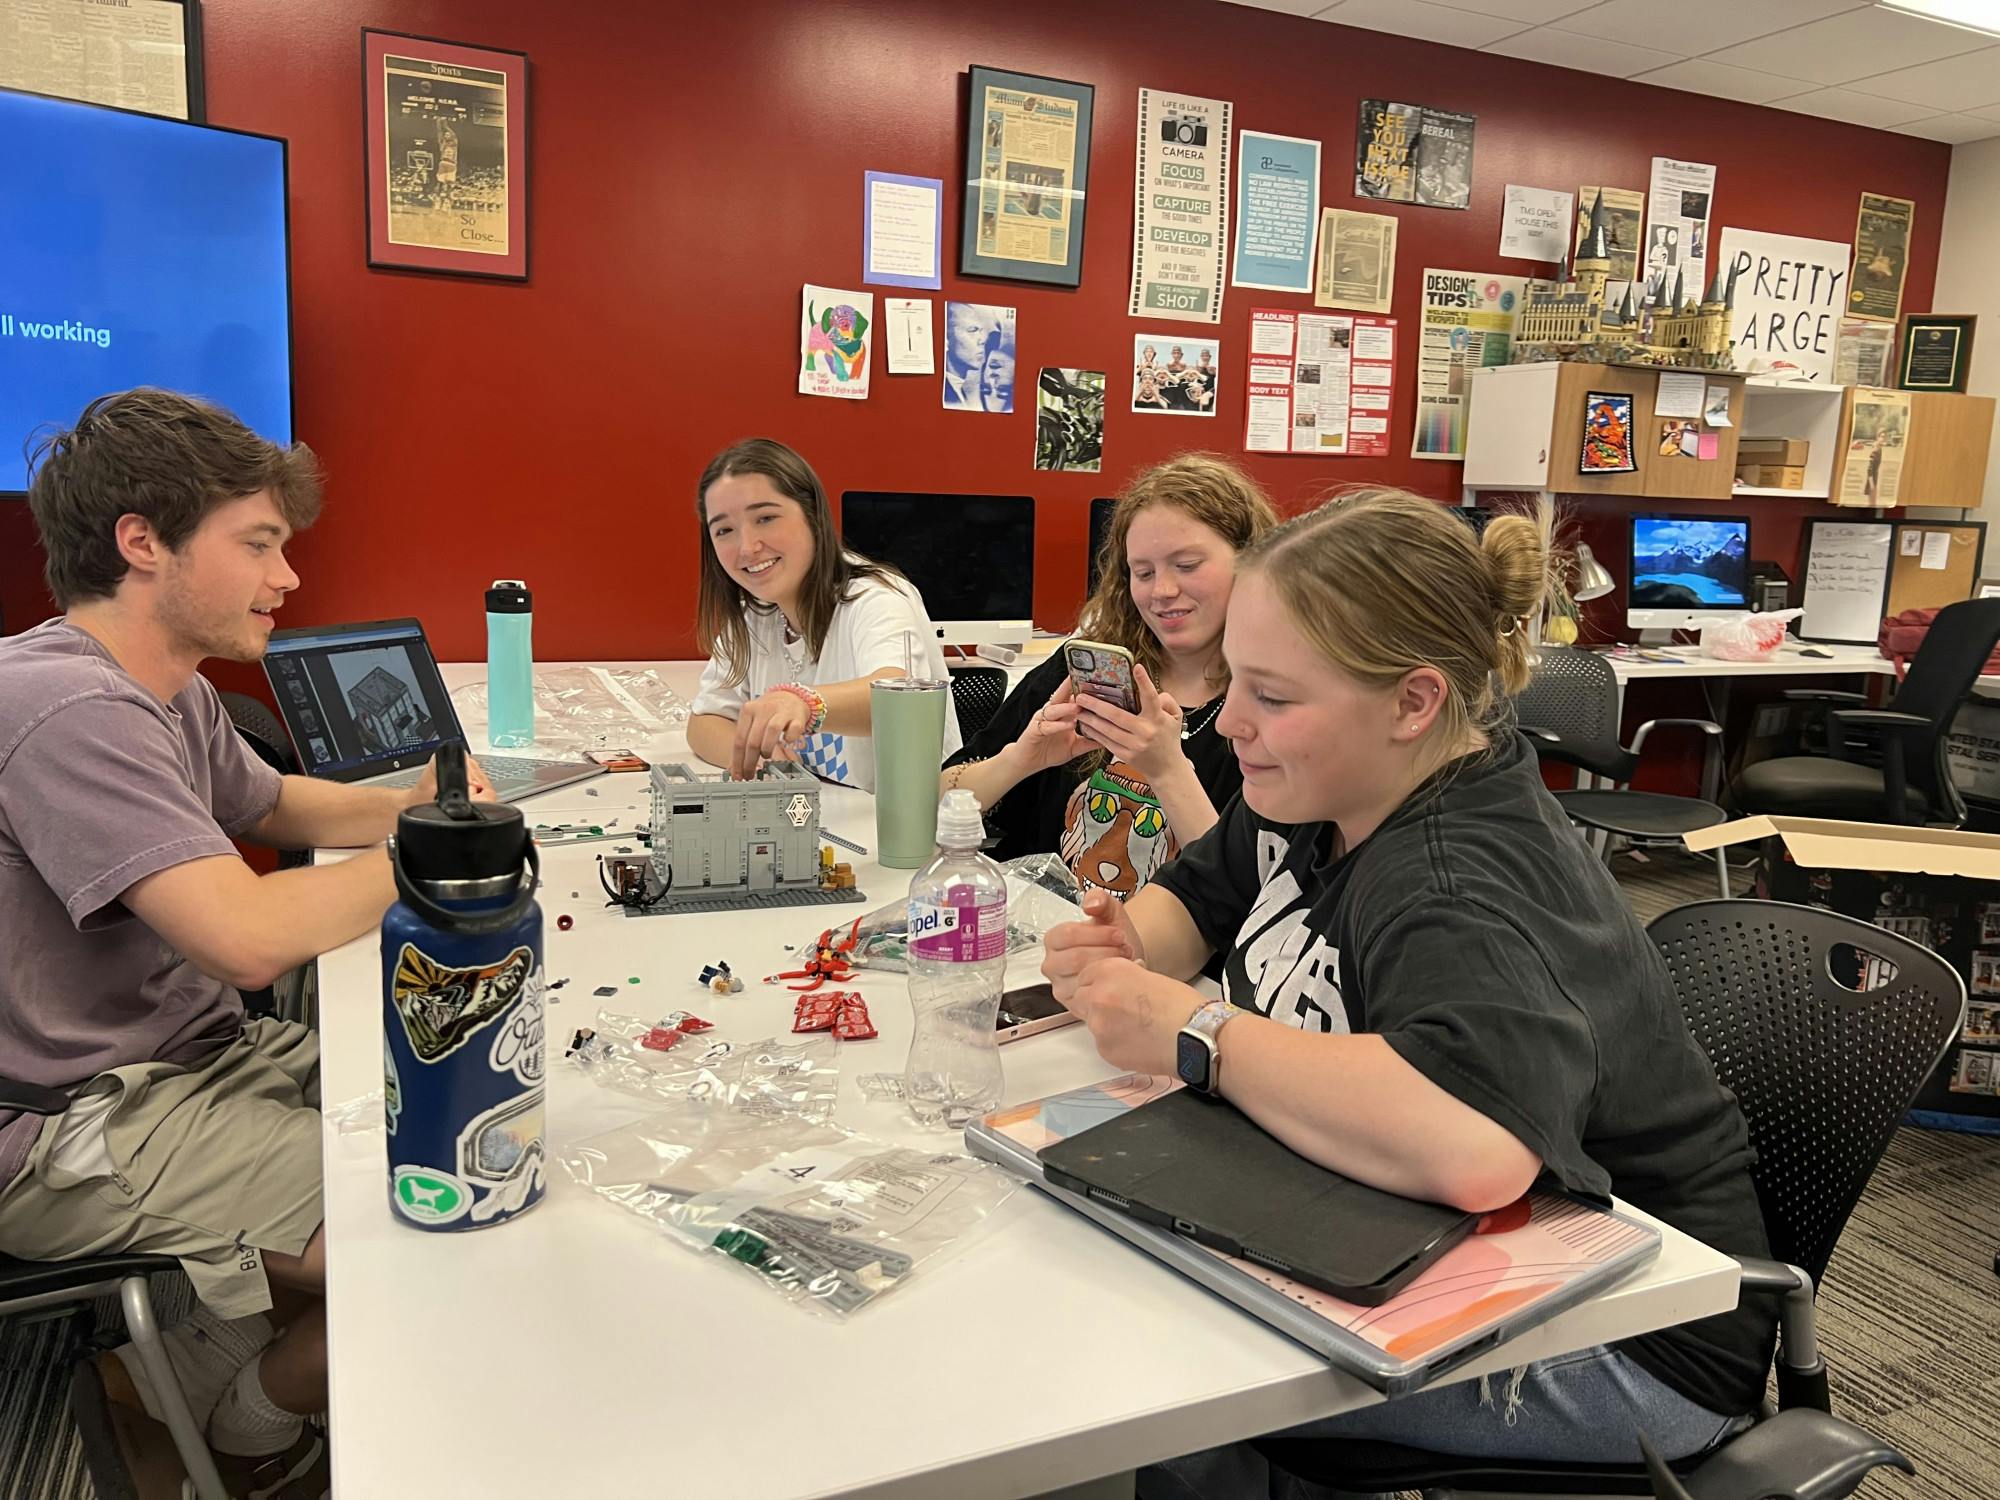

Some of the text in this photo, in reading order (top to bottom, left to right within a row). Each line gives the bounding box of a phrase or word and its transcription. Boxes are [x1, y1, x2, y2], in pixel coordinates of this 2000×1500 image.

[431, 64, 461, 77] Sports
[1162, 100, 1177, 109] LIFE
[1187, 104, 1202, 113] LIKE
[1376, 112, 1405, 129] SEE
[1373, 128, 1406, 146] YOU
[1421, 124, 1455, 139] BEREAL
[1162, 146, 1205, 160] CAMERA
[1368, 144, 1409, 163] NEXT
[1162, 164, 1203, 180] FOCUS
[1364, 161, 1409, 180] ISSUE
[1154, 197, 1210, 213] CAPTURE
[461, 214, 476, 226] So
[1515, 217, 1541, 228] HOUSE
[1154, 229, 1209, 245] DEVELOP
[1427, 275, 1468, 292] DESIGN
[1736, 251, 1844, 306] PRETTY
[1156, 293, 1198, 310] SHOT
[1426, 292, 1467, 307] TIPS
[1253, 312, 1295, 322] HEADLINES
[19, 320, 110, 348] working
[1740, 311, 1831, 354] ARGE
[1250, 386, 1289, 395] BODY TEXT
[789, 1166, 817, 1178] 4
